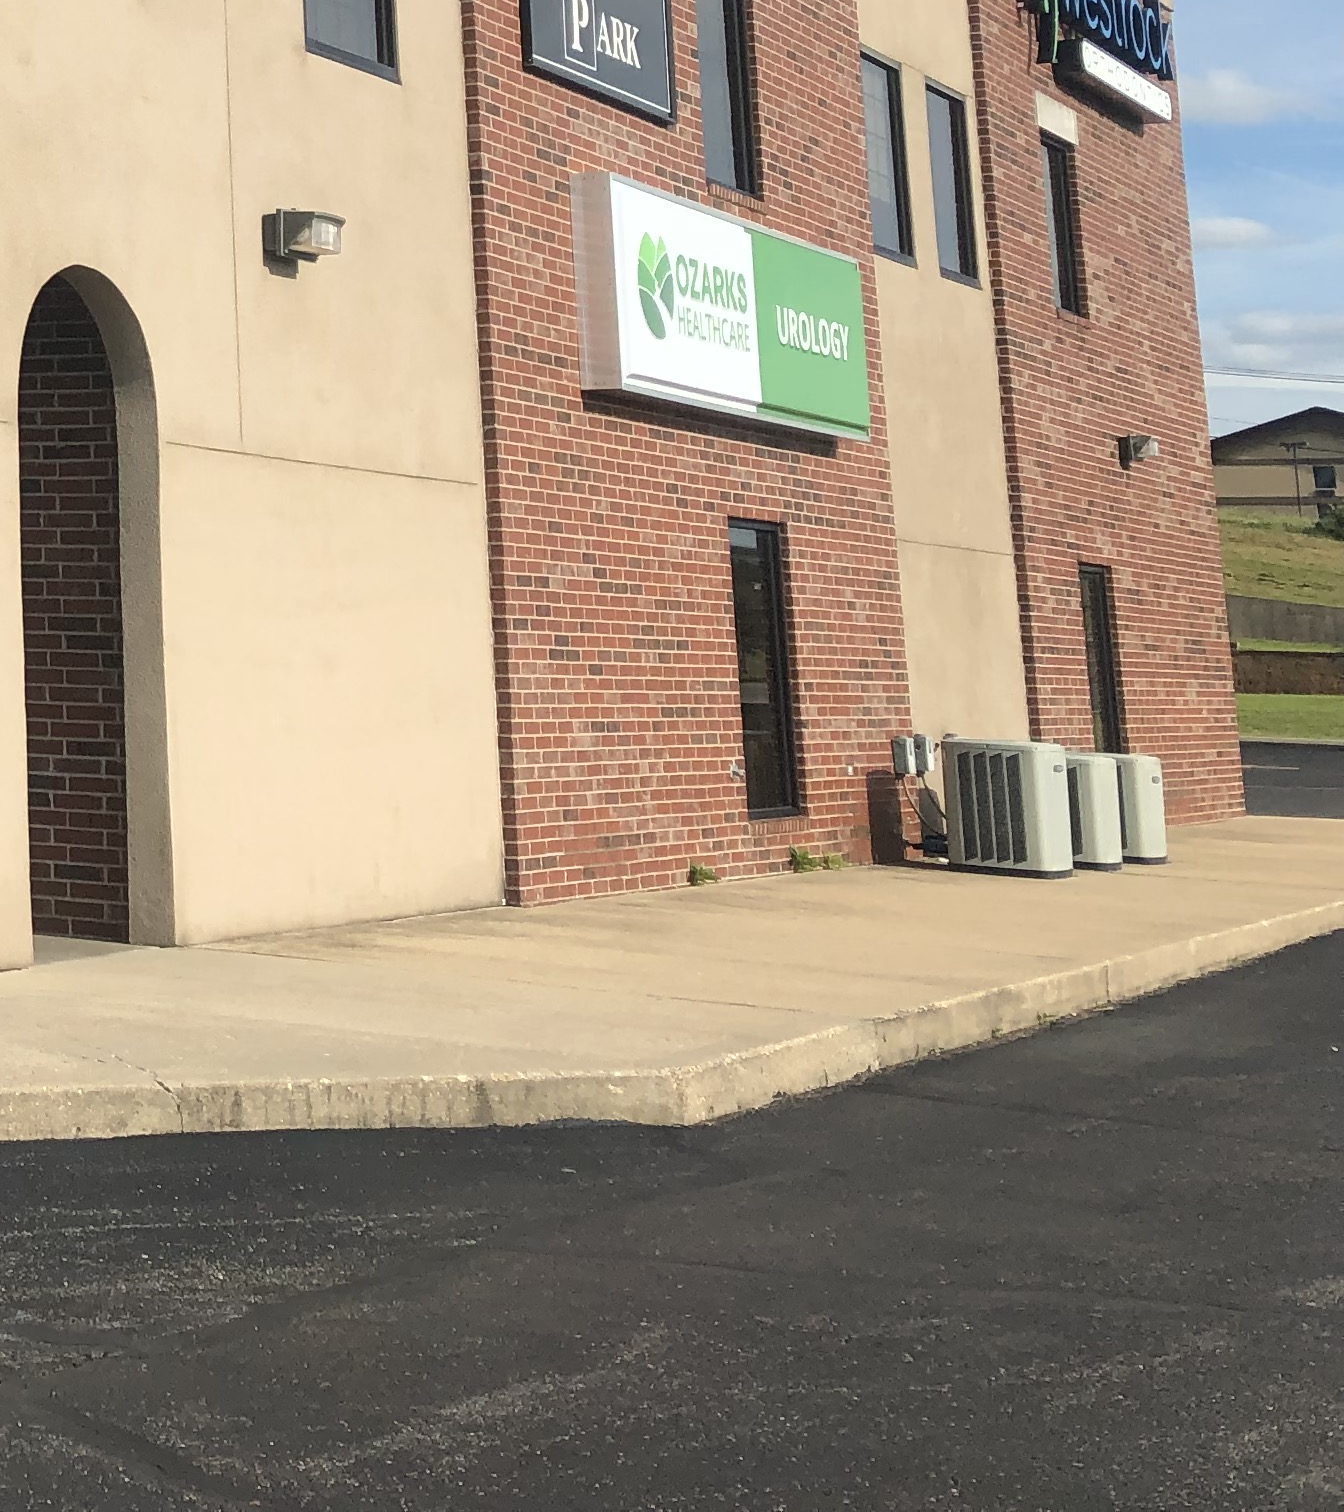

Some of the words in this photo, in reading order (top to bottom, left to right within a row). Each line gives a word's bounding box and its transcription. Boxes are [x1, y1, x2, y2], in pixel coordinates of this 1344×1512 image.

[675, 253, 748, 314] OZARKS
[677, 304, 751, 353] HEALTHCARE
[776, 304, 850, 362] UROLOGY
